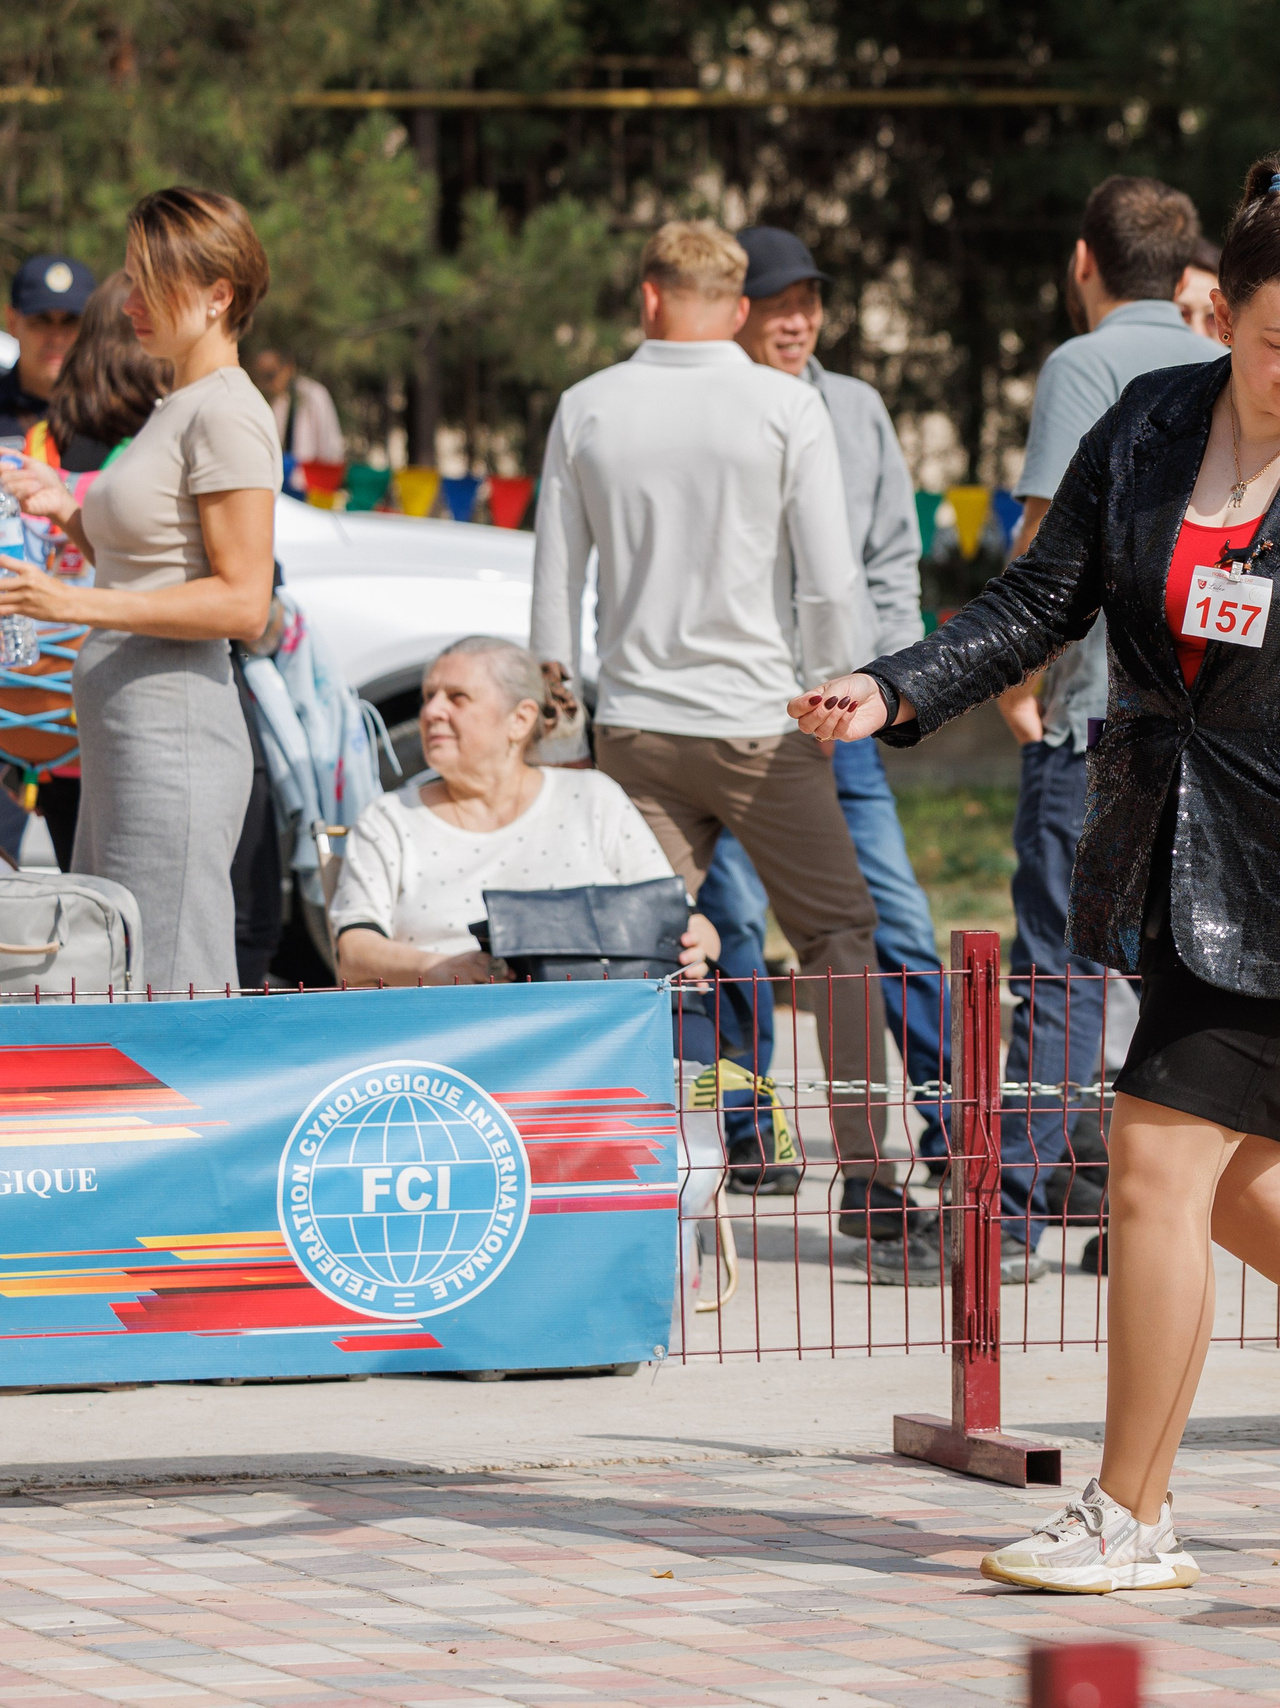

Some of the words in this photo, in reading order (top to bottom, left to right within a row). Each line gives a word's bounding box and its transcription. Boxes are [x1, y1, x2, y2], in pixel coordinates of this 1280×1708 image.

[1196, 597, 1262, 636] 157
[299, 1074, 464, 1157] CYNOLOGIQUE
[362, 1166, 451, 1213] FCI
[429, 1100, 518, 1300] INTERNATIONALE
[291, 1164, 379, 1302] FEDERATION
